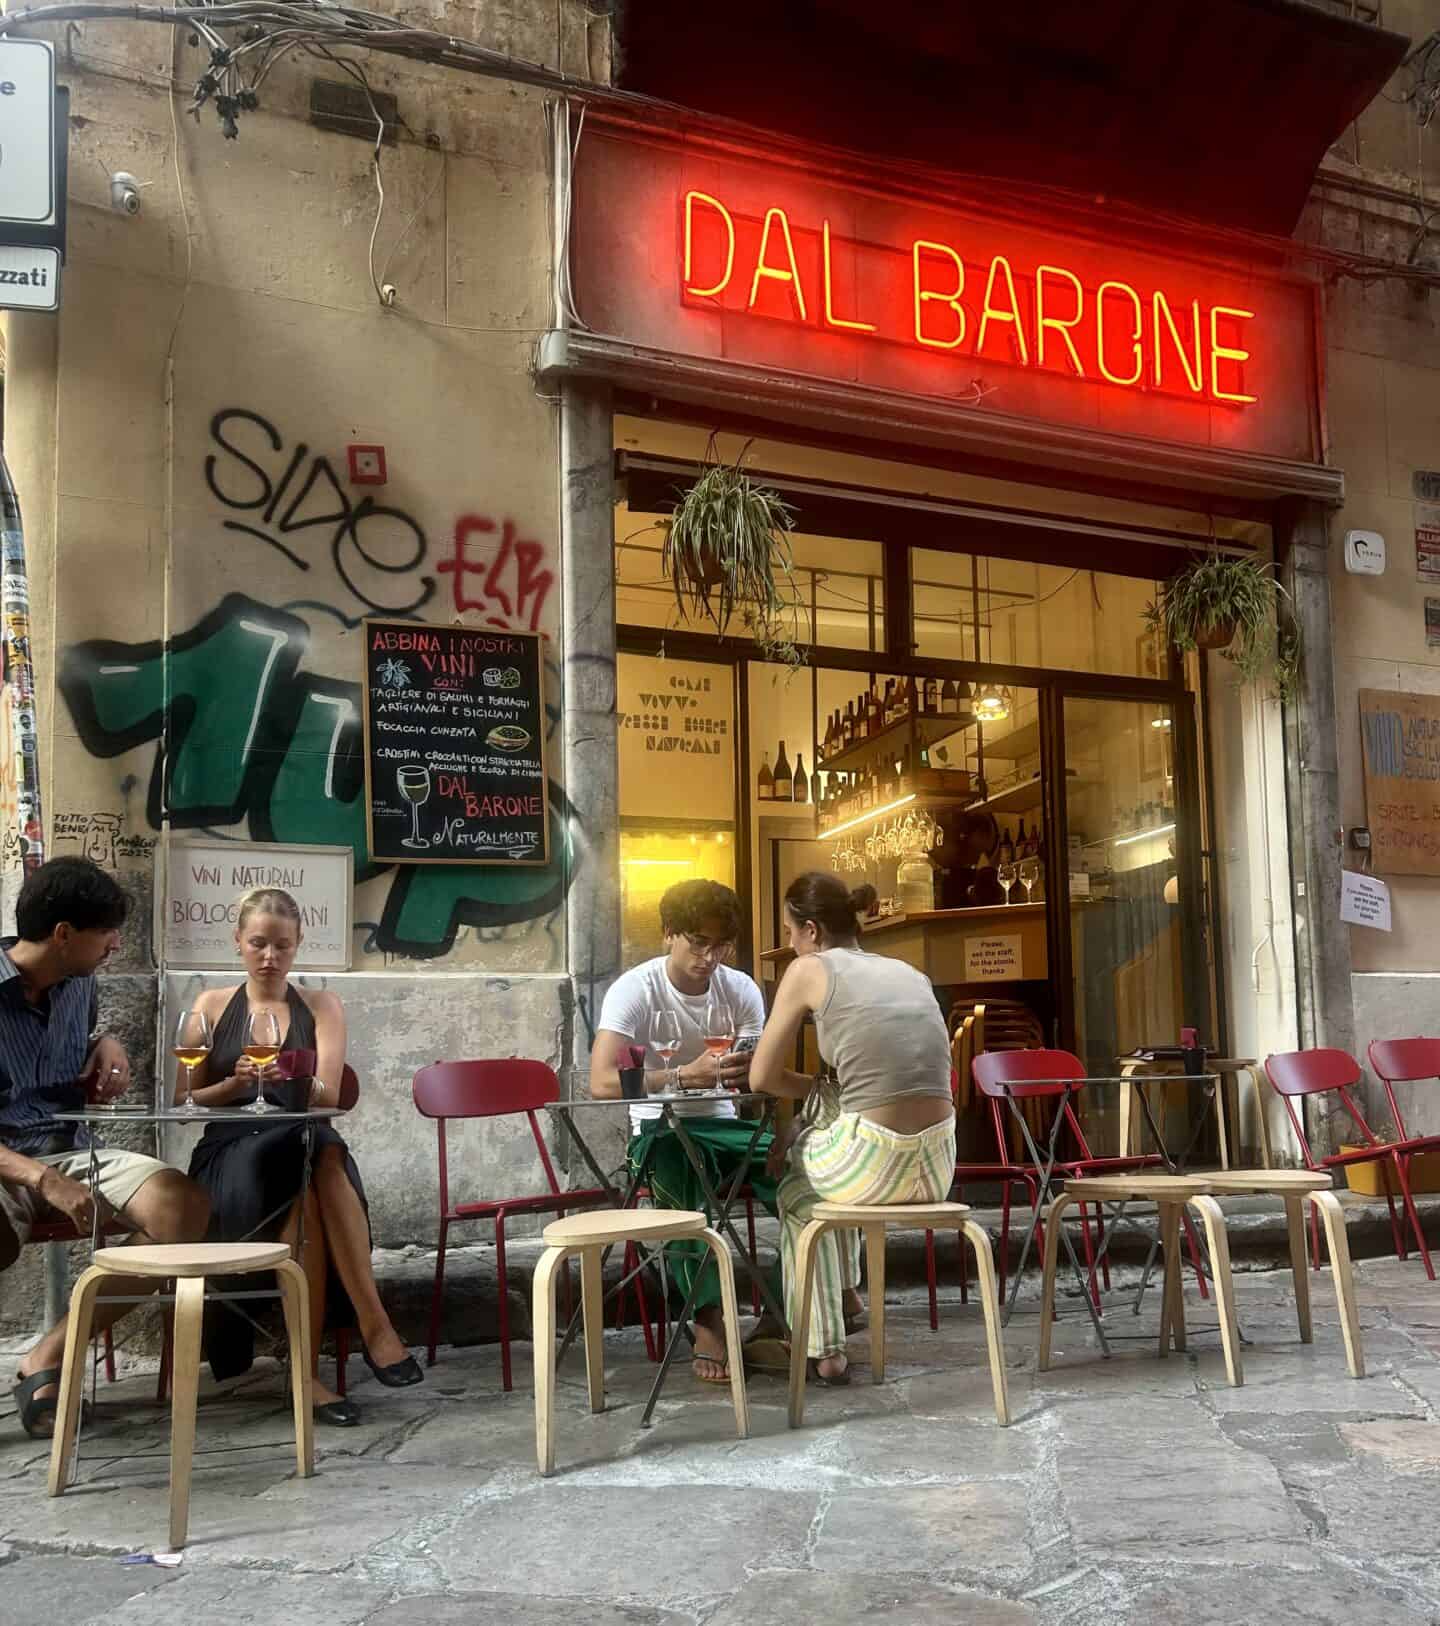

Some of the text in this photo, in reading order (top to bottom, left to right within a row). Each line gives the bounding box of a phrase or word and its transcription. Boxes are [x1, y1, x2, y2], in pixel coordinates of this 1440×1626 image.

[0, 267, 46, 286] zzati
[683, 190, 1257, 403] DAL BARONE
[372, 631, 525, 655] ABBINA I NOSTRI
[420, 654, 475, 677] VINI
[370, 687, 423, 700] TAGLIERE
[426, 691, 436, 701] DI
[376, 701, 446, 714] ARTIGIANALI
[463, 706, 519, 721] SICILIANI
[376, 720, 426, 735] FOCACCIA
[376, 747, 421, 760] CROSTINI
[438, 775, 475, 799] DAL
[464, 795, 543, 818] BARONE
[54, 814, 89, 824] TUTTO
[433, 816, 540, 847] NATURALMENTE
[191, 863, 304, 889] VINI NATURALI
[172, 898, 240, 925] BIOLOG
